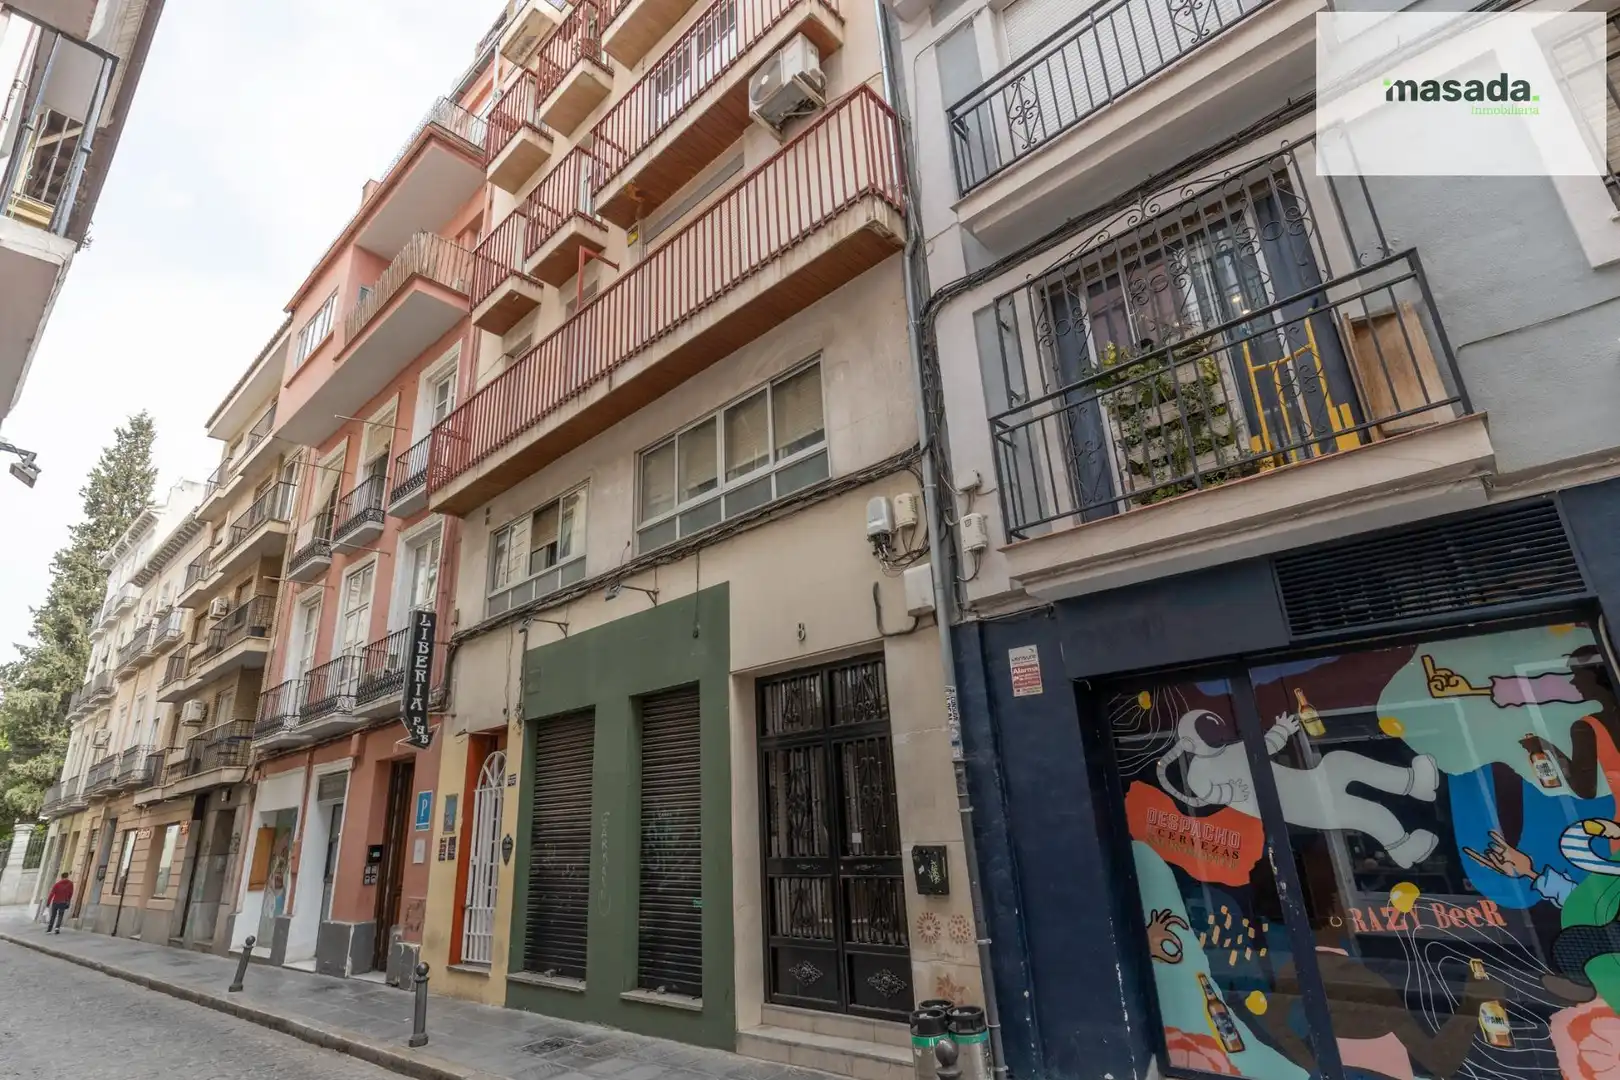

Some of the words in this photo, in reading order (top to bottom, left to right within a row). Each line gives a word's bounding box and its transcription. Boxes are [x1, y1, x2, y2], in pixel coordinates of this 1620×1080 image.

[796, 622, 807, 641] 8
[410, 613, 432, 711] LIBERIA
[1146, 807, 1241, 850] DESPACHO
[1157, 828, 1240, 860] CERVEZAS
